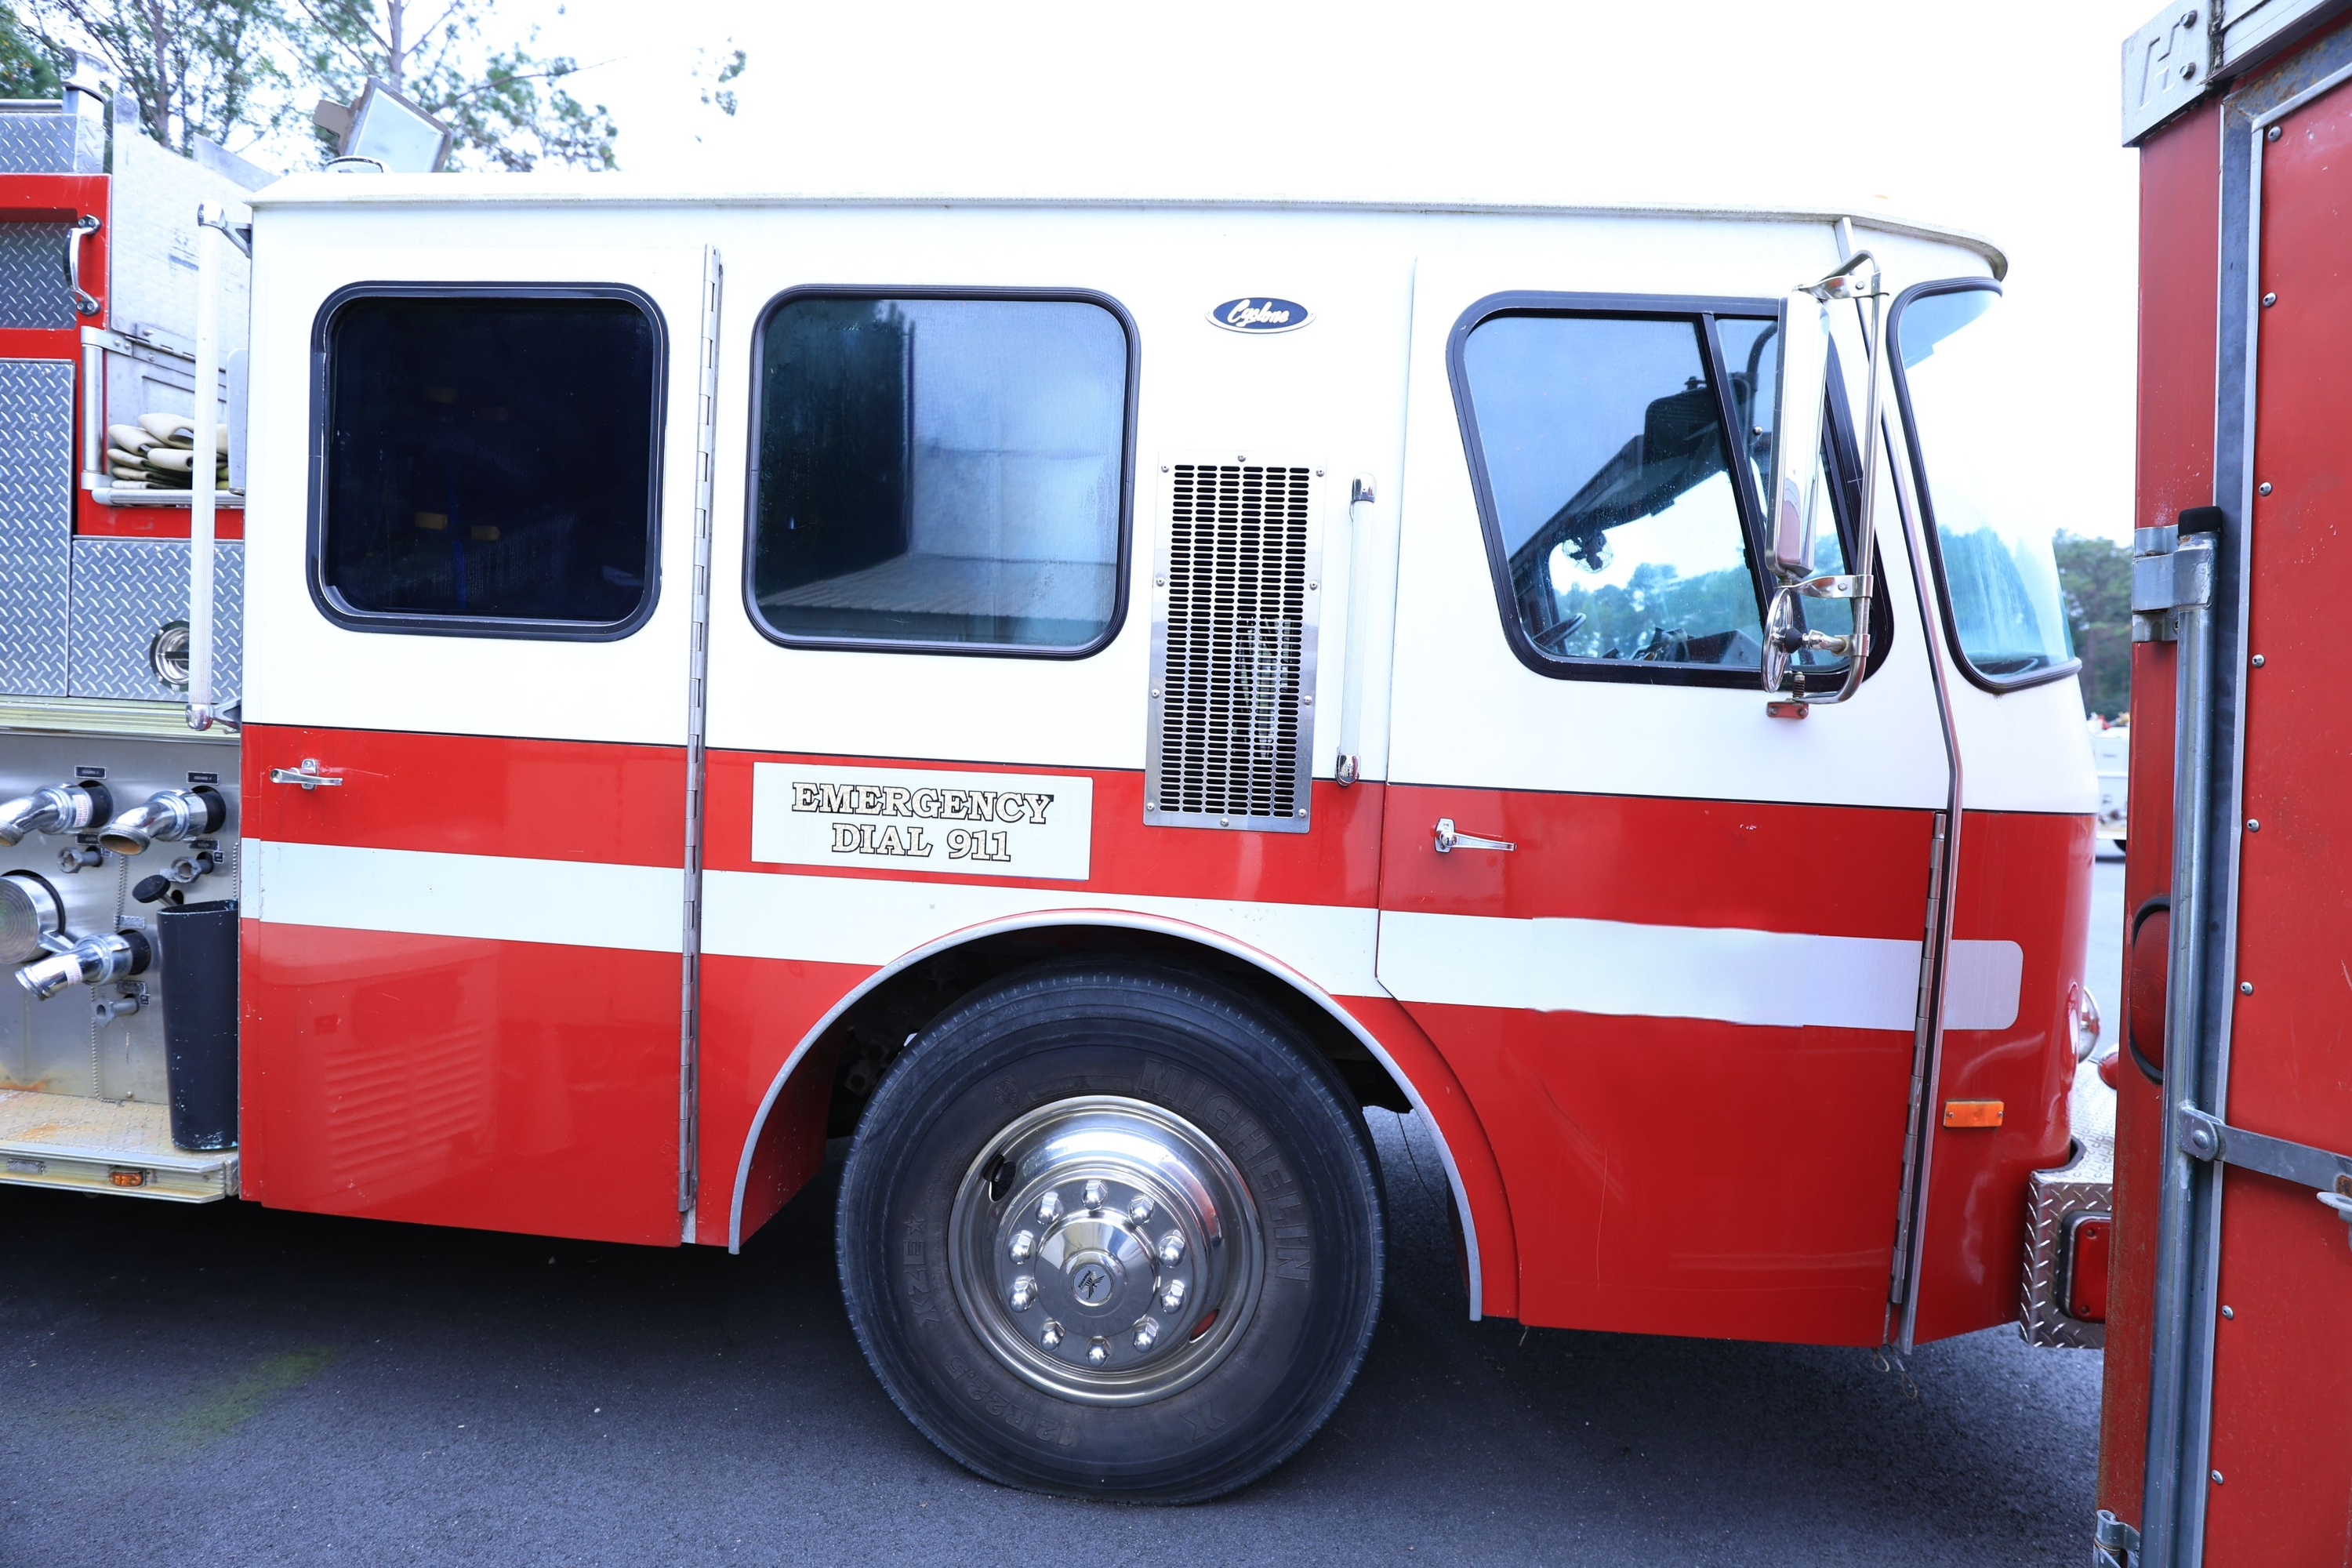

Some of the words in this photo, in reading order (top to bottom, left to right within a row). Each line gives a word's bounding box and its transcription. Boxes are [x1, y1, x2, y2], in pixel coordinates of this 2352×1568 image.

[792, 782, 1054, 824] EMERGENCY
[831, 822, 933, 858] DIAL
[946, 828, 1011, 862] 911
[1138, 1058, 1312, 1282] MICHELIN
[1077, 1270, 1091, 1289] Phoenix
